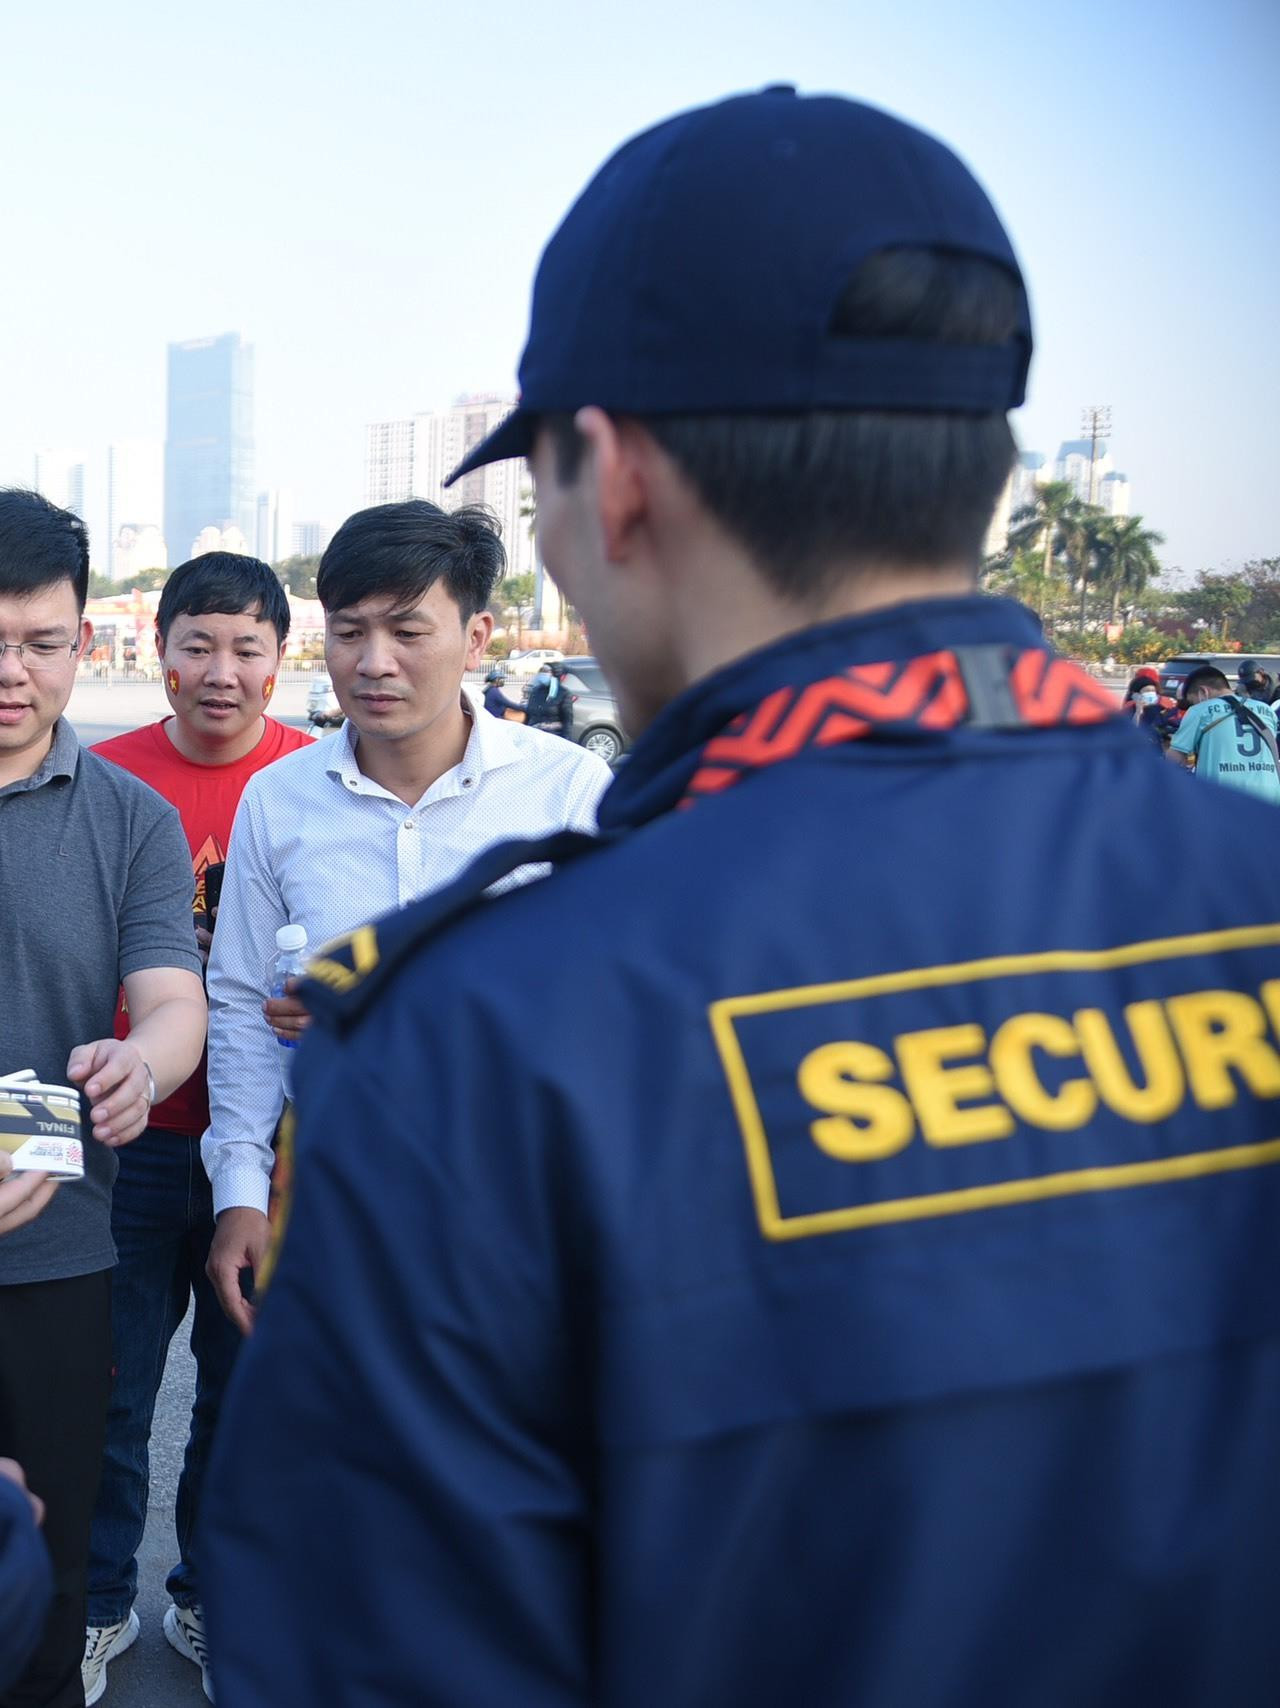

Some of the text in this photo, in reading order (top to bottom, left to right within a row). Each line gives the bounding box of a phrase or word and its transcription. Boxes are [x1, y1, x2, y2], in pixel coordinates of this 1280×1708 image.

[1208, 704, 1220, 714] FC
[1235, 716, 1261, 757] 5
[1219, 762, 1245, 772] Minh
[37, 1121, 75, 1134] FINAL
